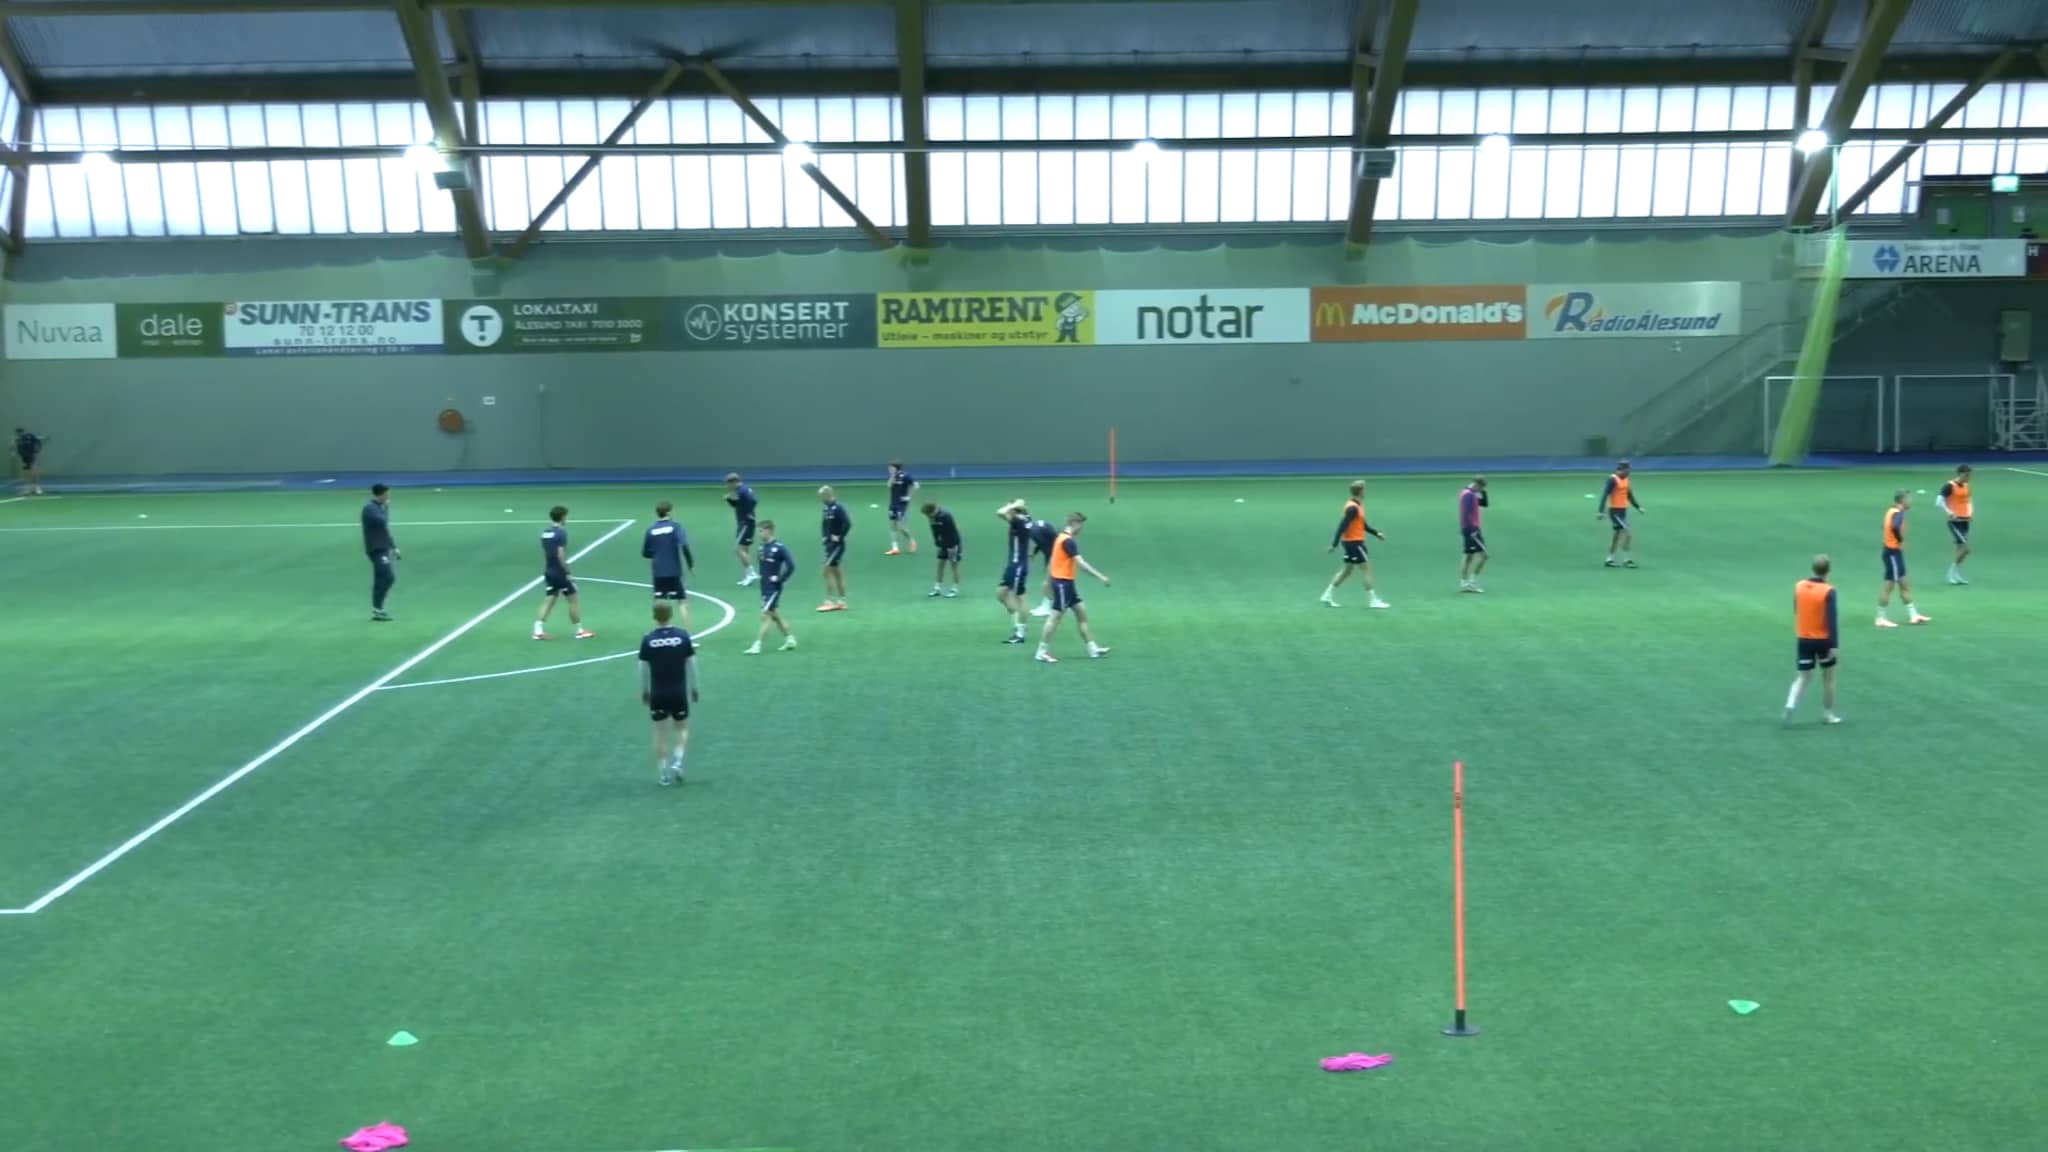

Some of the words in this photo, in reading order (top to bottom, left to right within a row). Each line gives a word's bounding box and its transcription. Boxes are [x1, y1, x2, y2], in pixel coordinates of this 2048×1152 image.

[1903, 255, 1982, 273] ARENA
[239, 301, 431, 325] SUNN-TRANS
[513, 303, 599, 316] LOKALTAXI
[724, 302, 849, 322] KONSERT
[881, 297, 1049, 324] RAMIRENT
[1137, 293, 1264, 340] notar
[1351, 301, 1523, 325] McDonald's
[17, 320, 103, 344] Nuvaa
[140, 313, 203, 337] dale
[300, 325, 315, 336] 70
[319, 325, 335, 336] 12
[340, 325, 354, 336] 12
[724, 322, 849, 344] systemer
